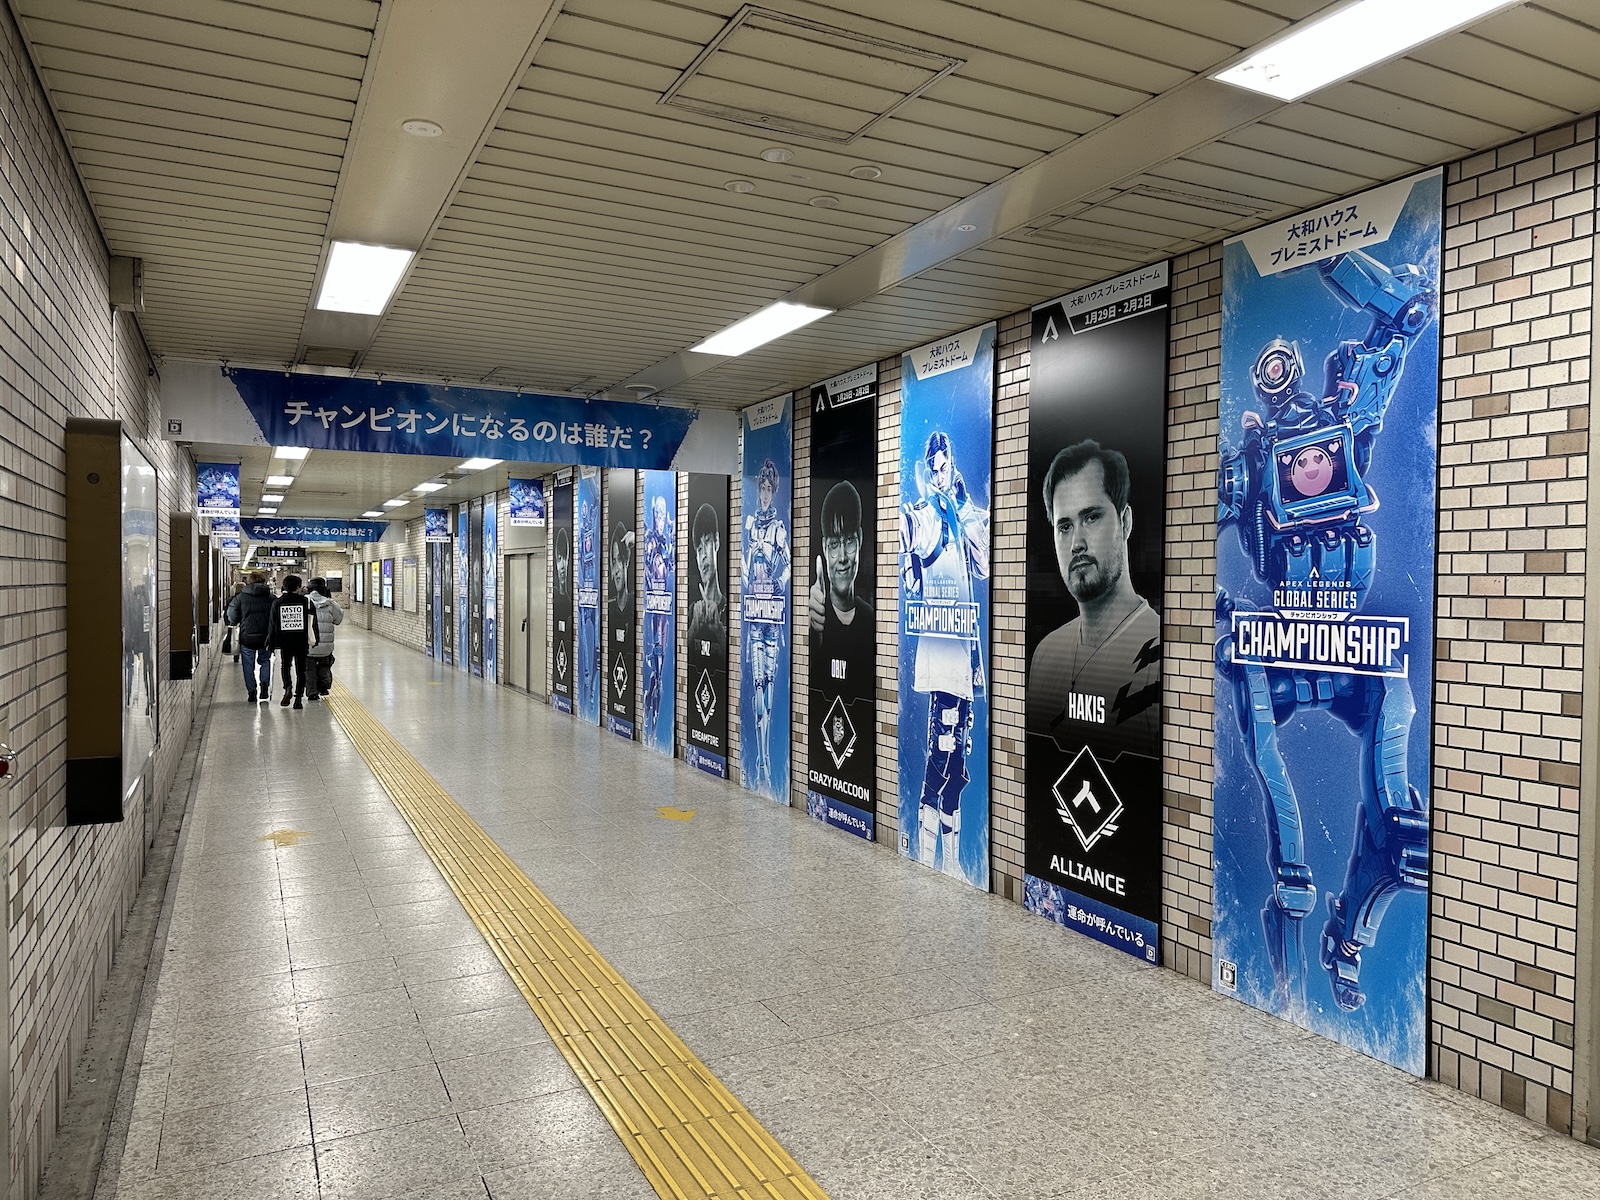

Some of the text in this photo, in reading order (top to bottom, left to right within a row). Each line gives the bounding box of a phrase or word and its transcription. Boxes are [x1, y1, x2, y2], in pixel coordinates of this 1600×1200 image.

[1287, 205, 1358, 241] 大和ハウス
[1270, 221, 1378, 265] プレミストドーム
[1070, 269, 1161, 308] 大和ハウス プレミストドーム
[1084, 305, 1116, 325] 1月29日
[1123, 293, 1152, 313] 2月2日
[922, 351, 968, 374] プレミストドーム
[929, 340, 960, 359] 大和ハウス
[284, 401, 653, 449] チャンピオンになるのは誰だ？
[253, 525, 374, 537] チャンピオンになるのは誰だ？
[924, 586, 959, 598] GLOBAL SERIES
[1279, 580, 1303, 588] APEX
[746, 599, 784, 619] CHAMPIONSHIP
[1273, 590, 1357, 609] GLOBAL SERIES
[908, 606, 977, 634] CHAMPIONSHIP
[1239, 620, 1400, 666] CHAMPIONSHIP
[831, 659, 847, 680] OBLY
[1068, 692, 1106, 724] HAKIS
[692, 729, 720, 748] DREAMFIRE
[809, 769, 870, 802] CRAZY RACCOON
[1050, 854, 1126, 897] ALLIANCE
[1067, 904, 1145, 947] 運命が呼んでいる
[1223, 968, 1233, 982] D
